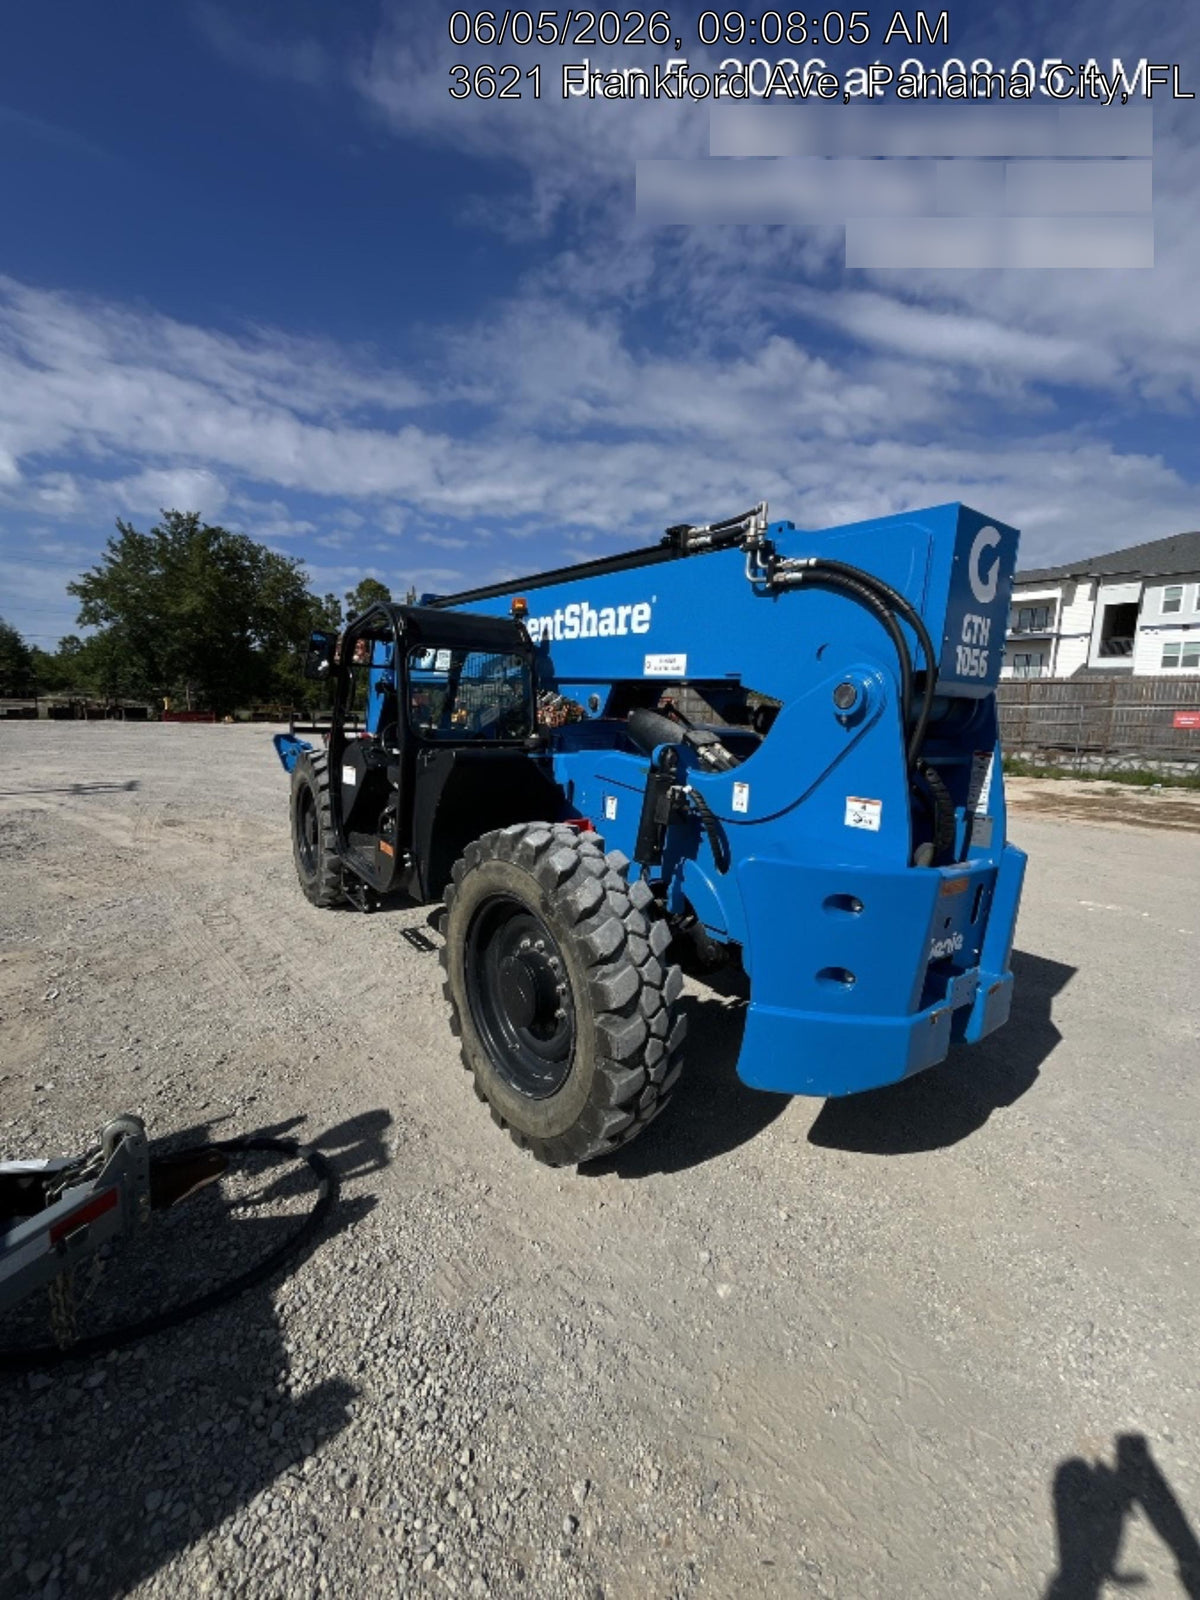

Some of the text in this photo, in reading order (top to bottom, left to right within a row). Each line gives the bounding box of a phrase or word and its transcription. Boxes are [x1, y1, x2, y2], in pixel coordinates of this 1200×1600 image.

[524, 601, 652, 643] entShare
[961, 612, 991, 647] GTH
[955, 644, 990, 678] 1056
